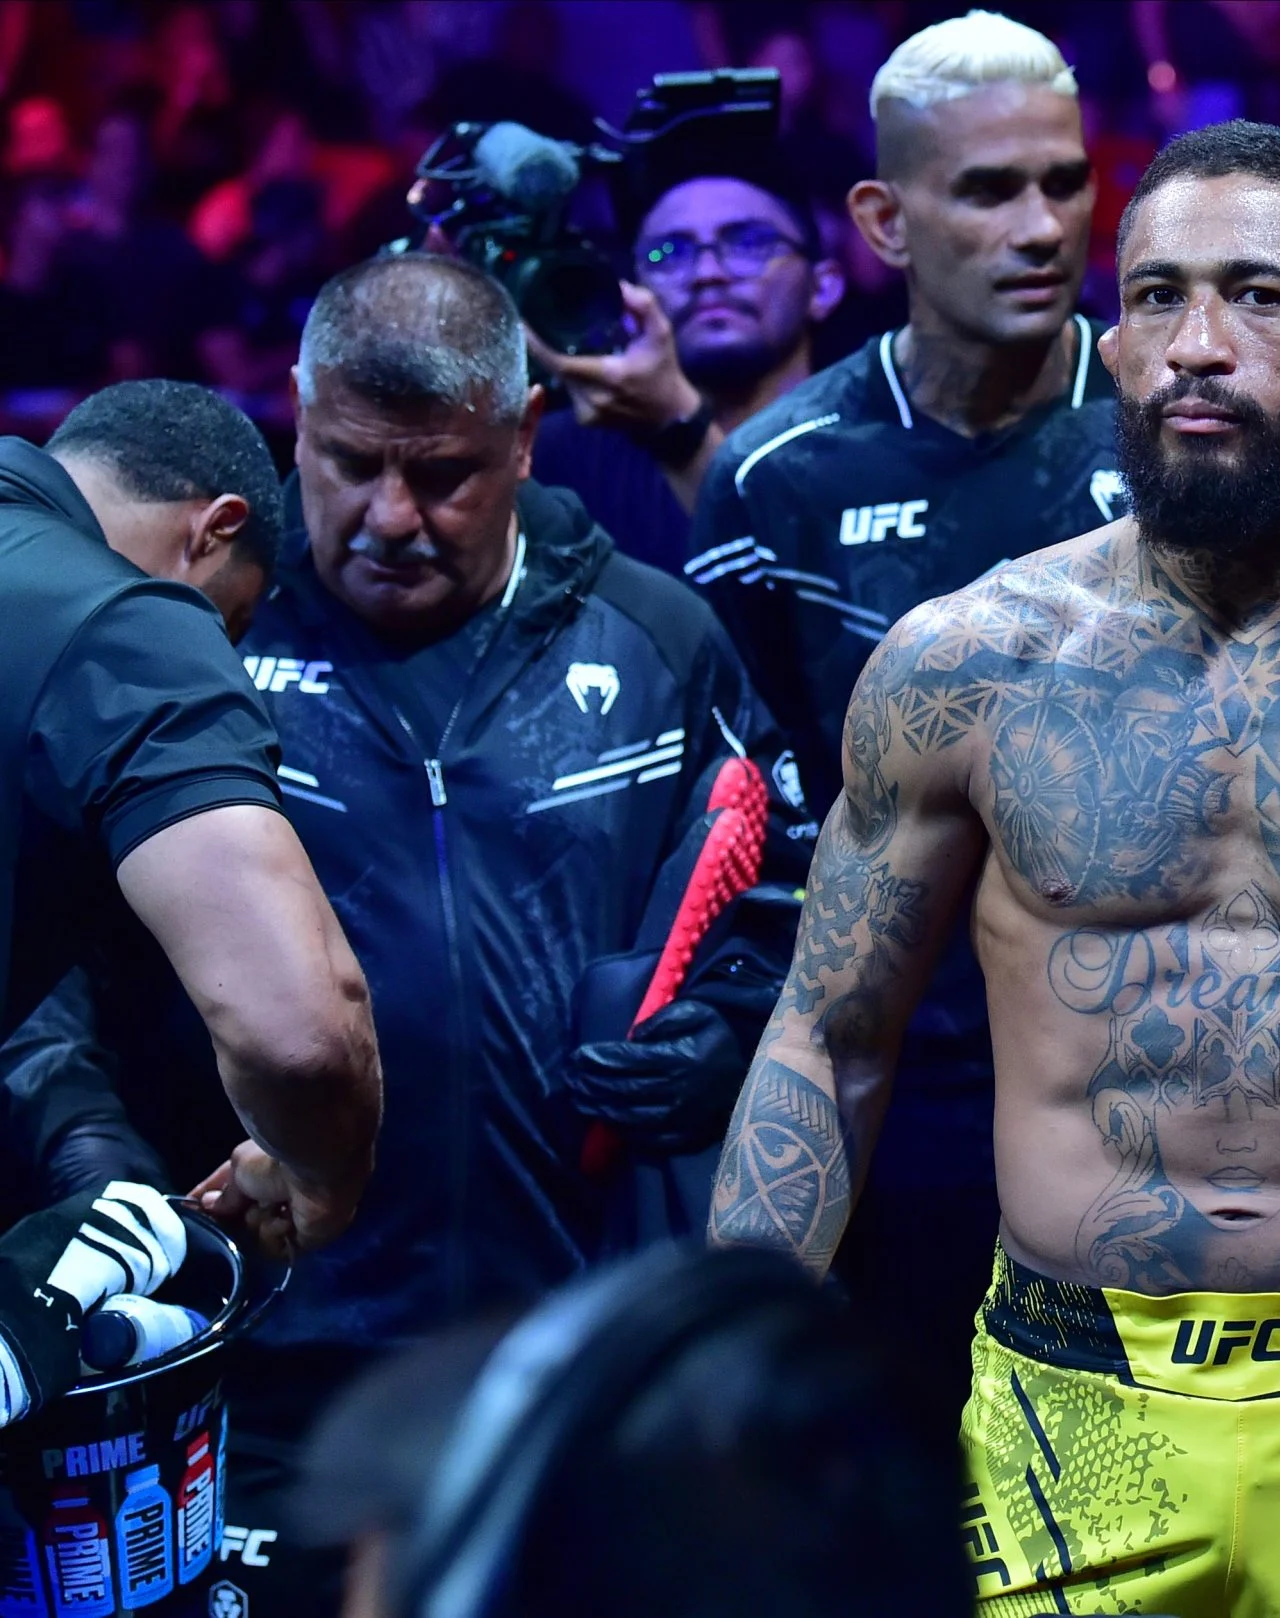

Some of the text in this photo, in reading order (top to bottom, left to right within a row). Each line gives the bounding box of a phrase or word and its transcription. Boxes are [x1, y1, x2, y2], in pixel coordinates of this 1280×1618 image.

[840, 500, 928, 545] UFC
[243, 656, 333, 694] UFC
[42, 1431, 146, 1479] PRIME
[55, 1522, 105, 1604] PRIME
[124, 1502, 167, 1593] PRIME
[220, 1525, 278, 1567] FC
